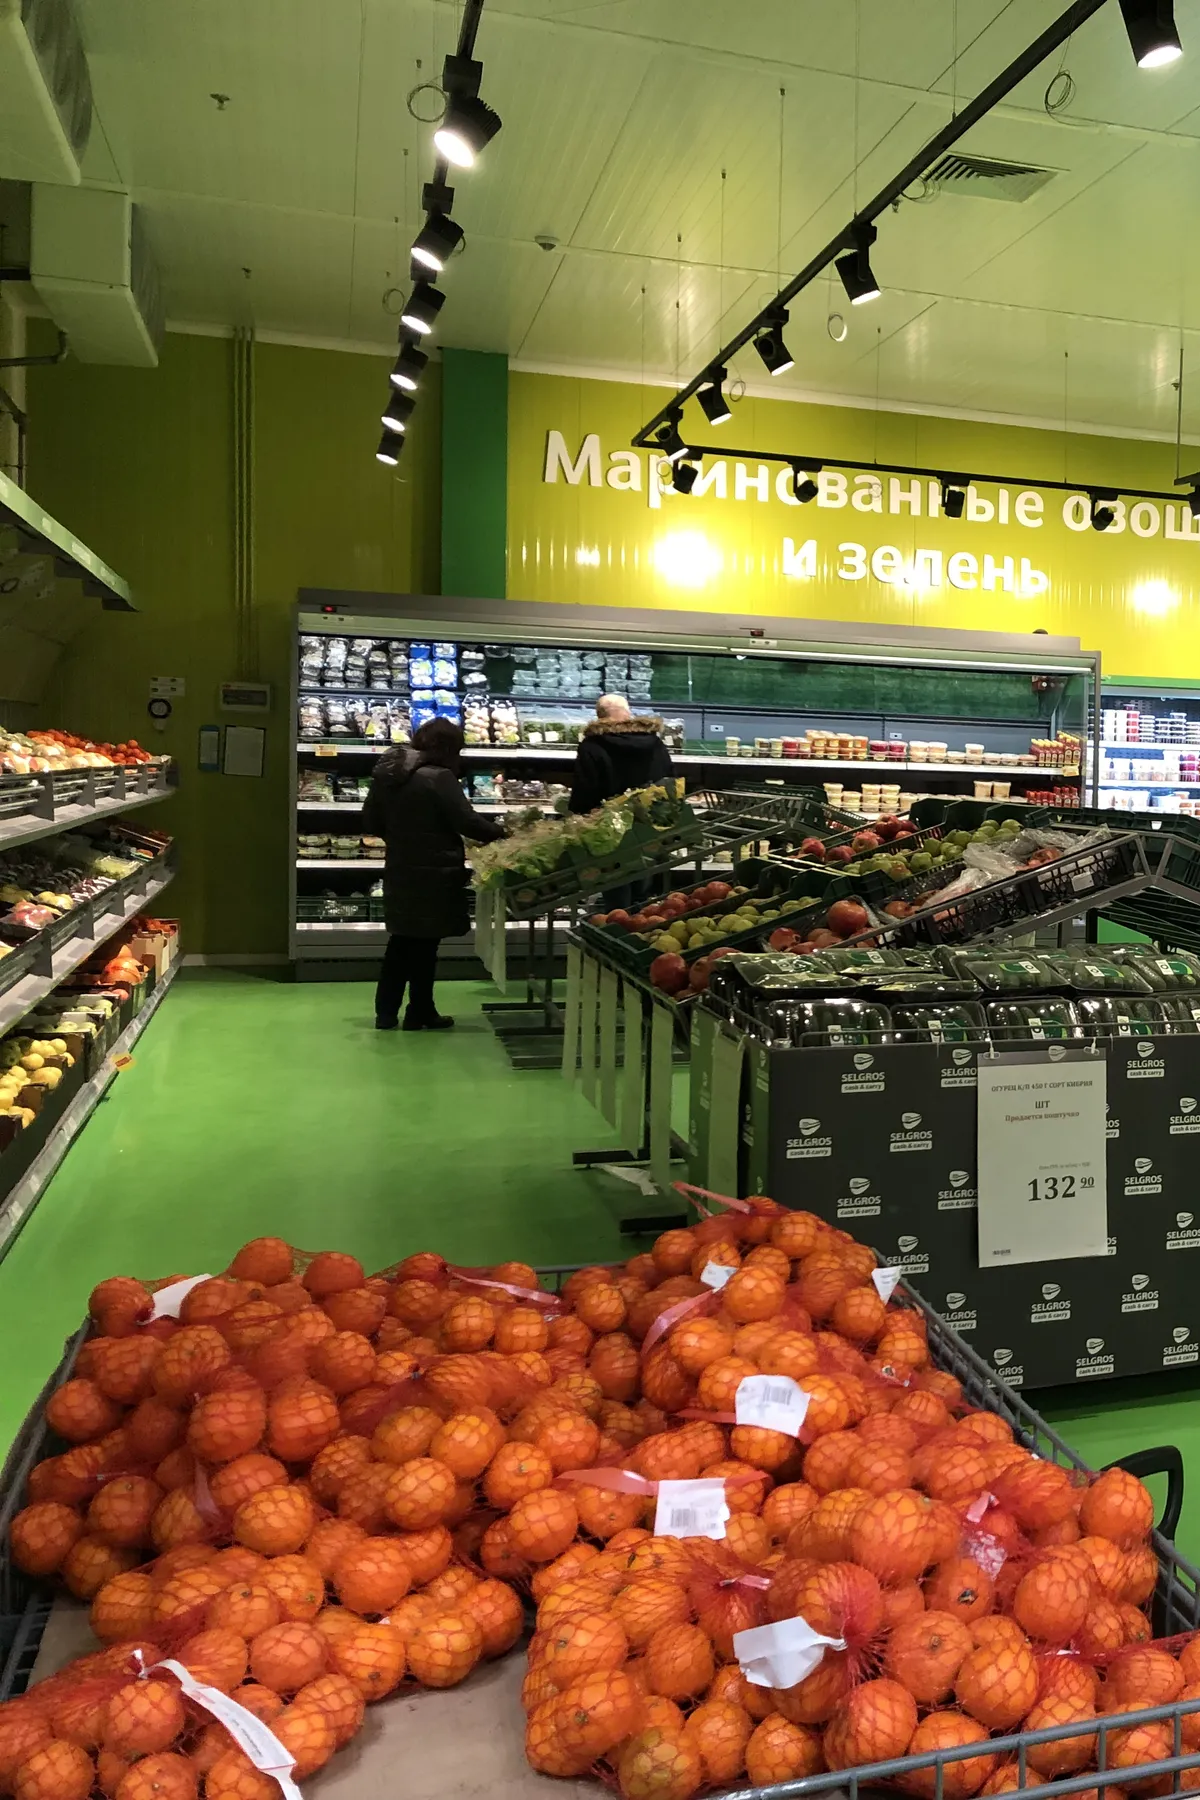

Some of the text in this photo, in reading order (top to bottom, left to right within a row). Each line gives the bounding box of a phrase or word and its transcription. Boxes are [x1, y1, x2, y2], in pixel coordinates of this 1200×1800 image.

[782, 537, 1049, 594] и зелень
[1127, 1060, 1164, 1068] SELGROS
[842, 1072, 884, 1082] SELGROS
[941, 1067, 977, 1077] SELGRO
[991, 1084, 1017, 1092] ОГУРЕЦ
[1035, 1100, 1051, 1109] ШТ
[891, 1131, 932, 1141] SELGROS
[787, 1138, 832, 1147] SELGROS
[1125, 1175, 1162, 1185] SELGROS
[1028, 1175, 1095, 1202] 132 90
[838, 1196, 881, 1206] SELGROS
[887, 1253, 929, 1264] SELGROS
[1122, 1291, 1158, 1302] SELGROS
[1032, 1301, 1070, 1312] SELGROS
[937, 1310, 977, 1320] ELGROS
[1164, 1343, 1198, 1355] SELGROS
[1076, 1355, 1114, 1366] SELGROS
[994, 1366, 1023, 1376] LGROS
